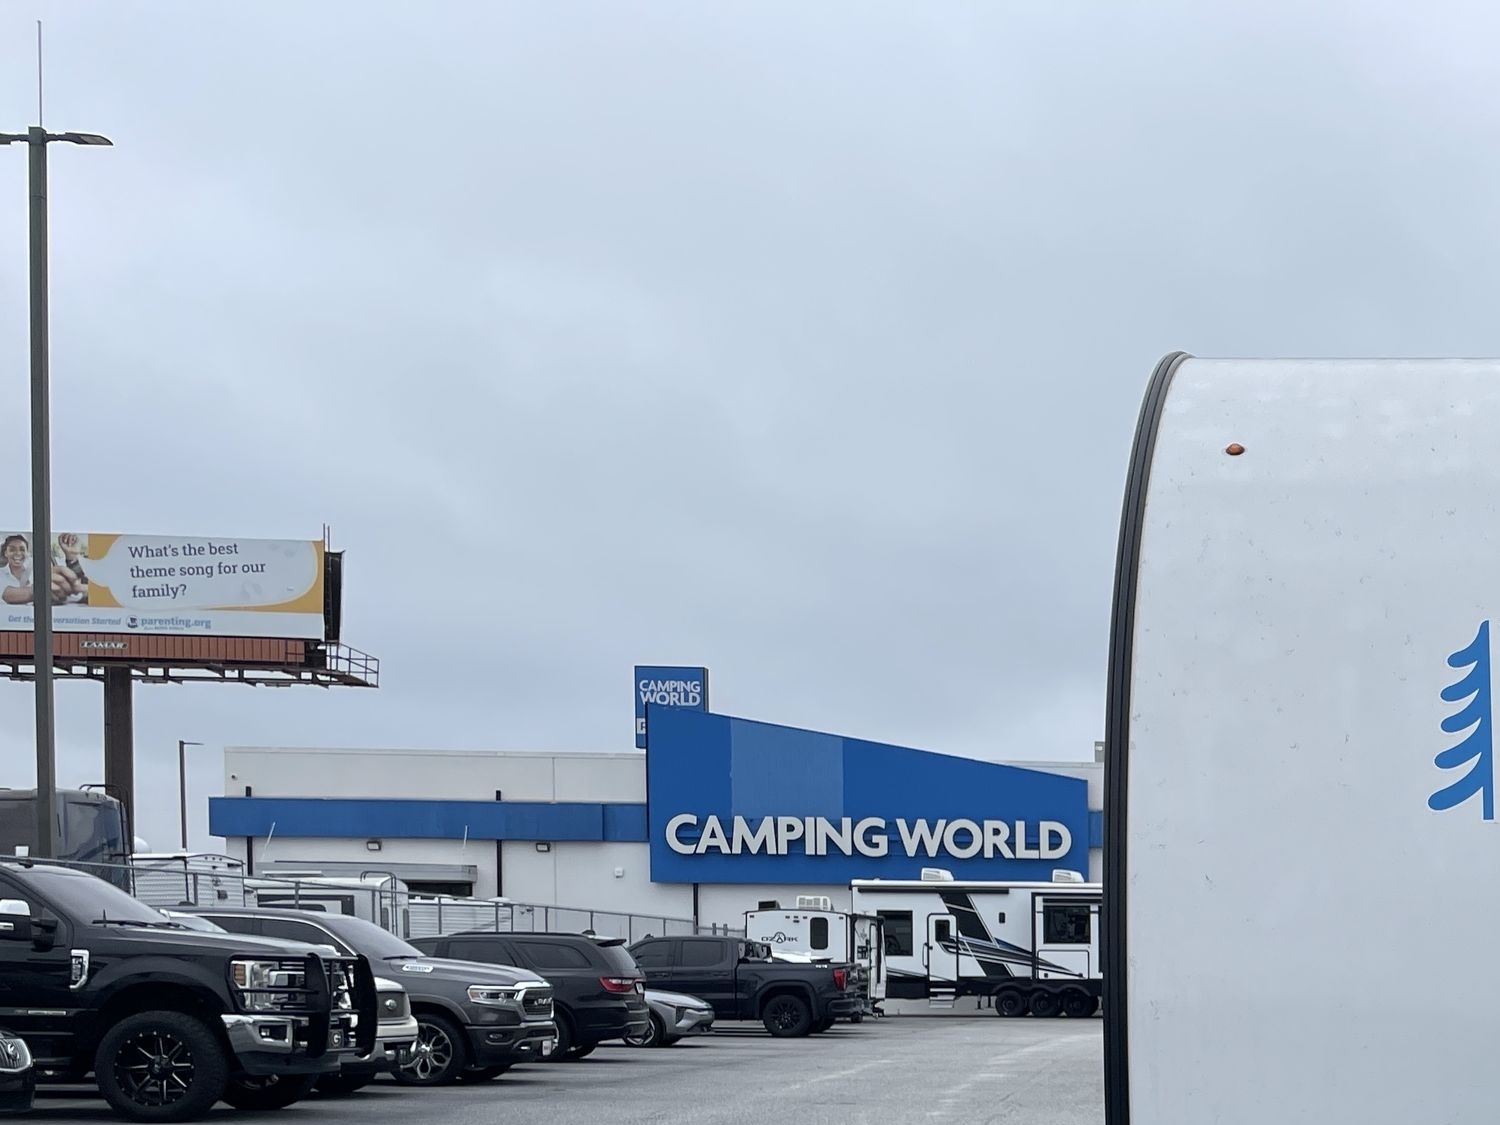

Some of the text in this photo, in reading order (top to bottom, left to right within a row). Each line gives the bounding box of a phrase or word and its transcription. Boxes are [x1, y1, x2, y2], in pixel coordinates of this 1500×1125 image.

[128, 542, 239, 559] What's the best
[130, 561, 267, 579] theme song for our
[131, 583, 187, 600] family?
[8, 614, 22, 623] Get
[91, 617, 122, 626] Started
[141, 617, 212, 630] parenting.org
[639, 679, 701, 693] CAMPING
[639, 690, 701, 707] WORLD
[665, 813, 1073, 861] CAMPING WORLD
